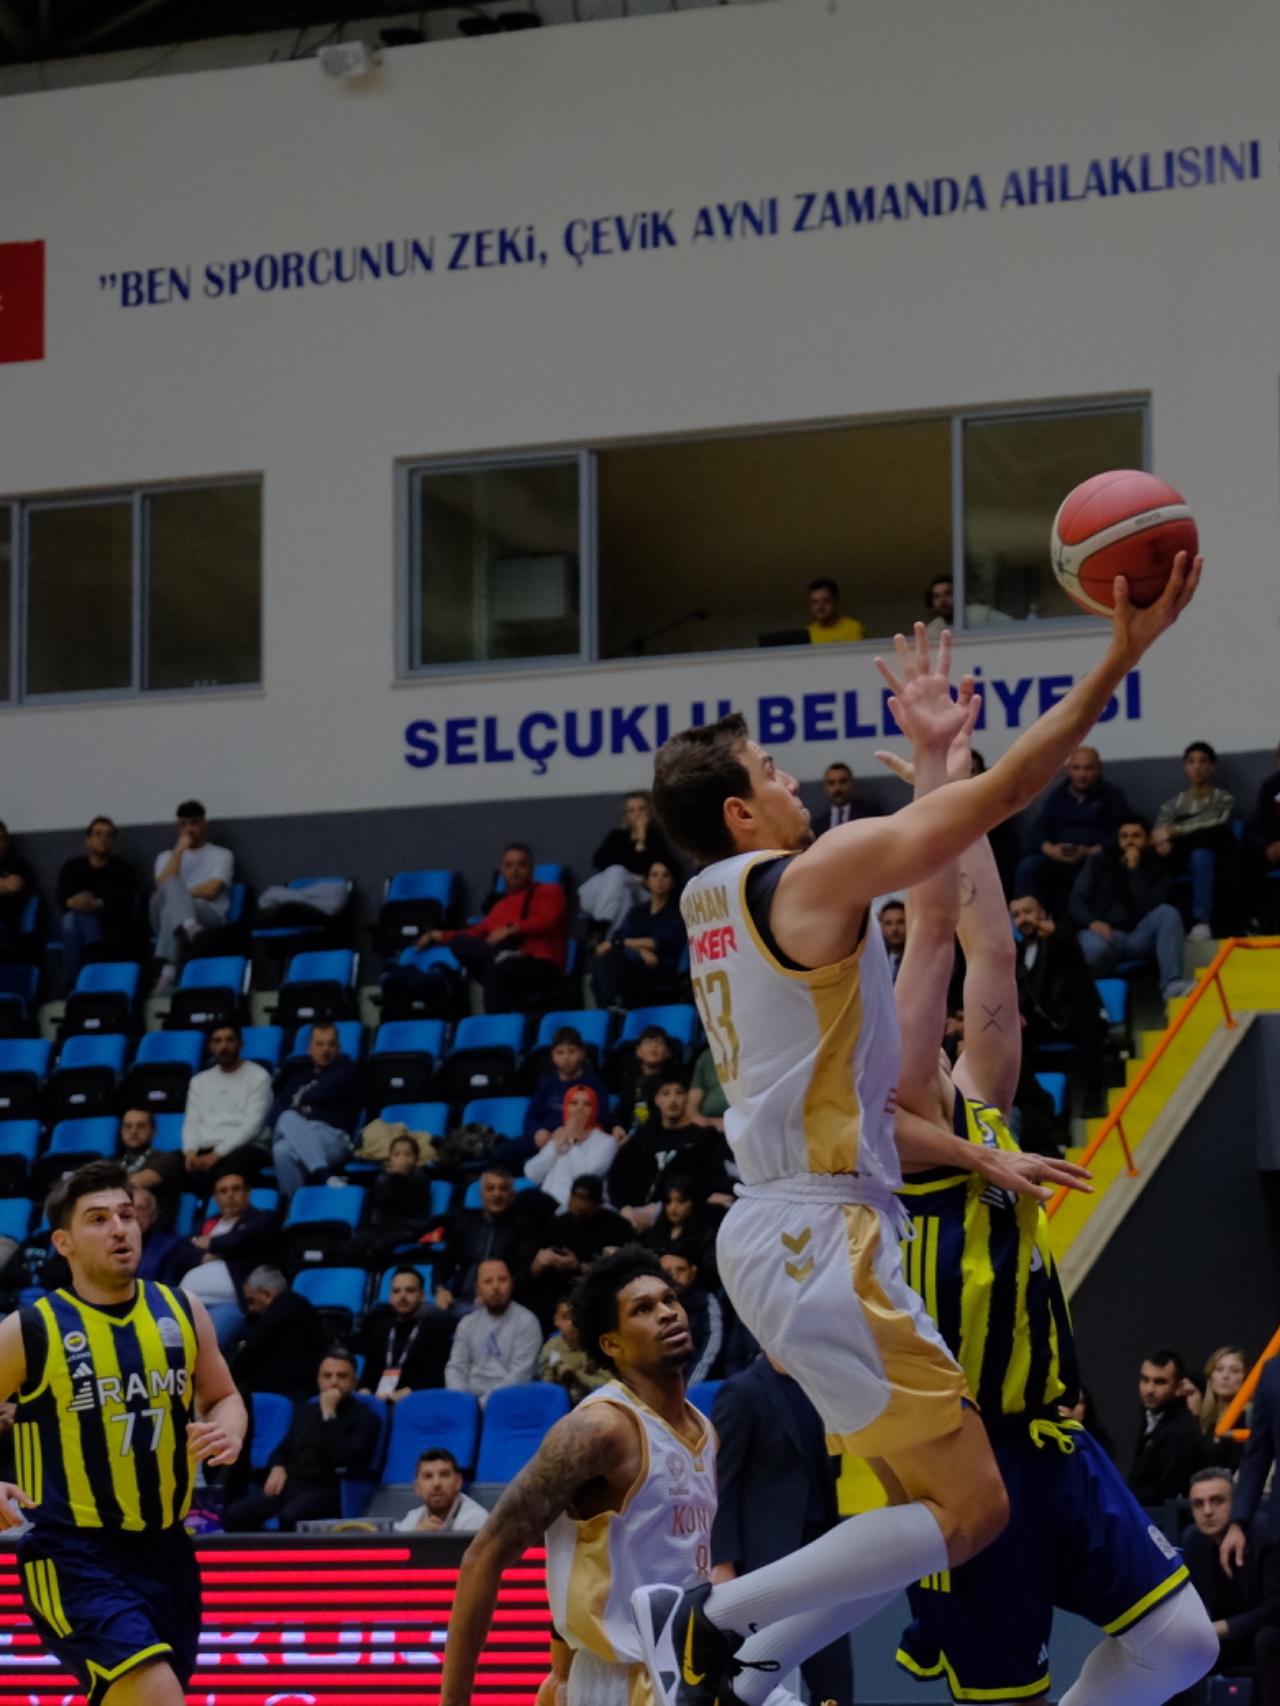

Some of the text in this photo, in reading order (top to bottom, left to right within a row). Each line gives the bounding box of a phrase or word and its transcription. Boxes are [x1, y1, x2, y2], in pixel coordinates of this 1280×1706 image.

[203, 237, 435, 298] SPORCUNUN
[692, 199, 780, 242] AYNI
[791, 175, 987, 233] ZAMANDA
[1000, 140, 1261, 208] AHLAKLISINI
[97, 1368, 188, 1406] RAMS
[111, 1407, 165, 1456] 77
